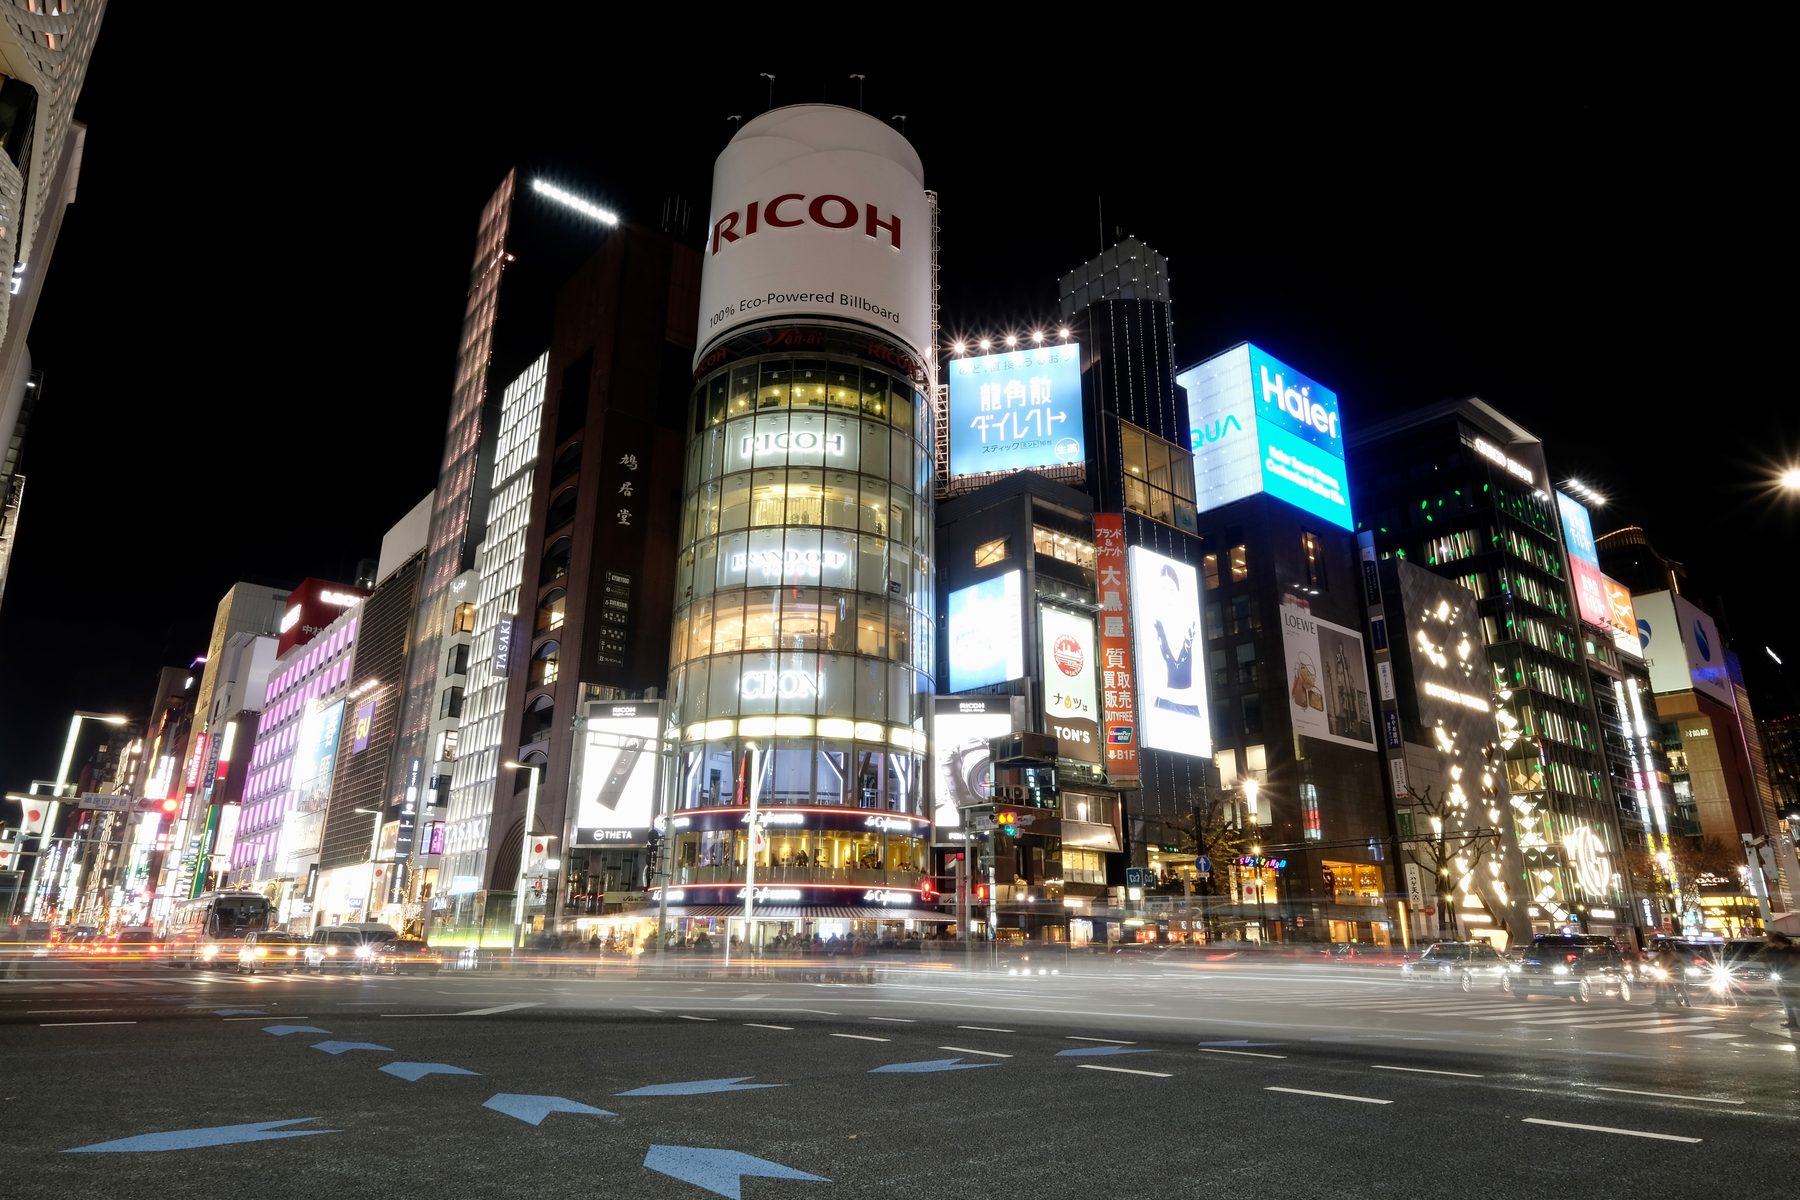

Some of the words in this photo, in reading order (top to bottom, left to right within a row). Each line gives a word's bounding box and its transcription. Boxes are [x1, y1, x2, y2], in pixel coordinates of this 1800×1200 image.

[711, 193, 902, 257] RICOH
[709, 305, 735, 328] 100%
[739, 291, 834, 313] Eco-Powered
[839, 295, 900, 325] Billboard
[1260, 365, 1337, 439] Haier
[741, 431, 844, 455] RICOH
[617, 453, 638, 526] 鳩居堂
[1095, 527, 1122, 540] ブランド
[1105, 539, 1113, 547] &
[1100, 565, 1125, 638] 大黒屋
[1284, 612, 1316, 635] LOEWE
[495, 619, 512, 670] TASAKI
[356, 715, 371, 740] GU
[1053, 725, 1091, 744] TON'S
[1117, 749, 1136, 760] B1F
[445, 818, 487, 844] TASAKI
[604, 830, 632, 839] THETA
